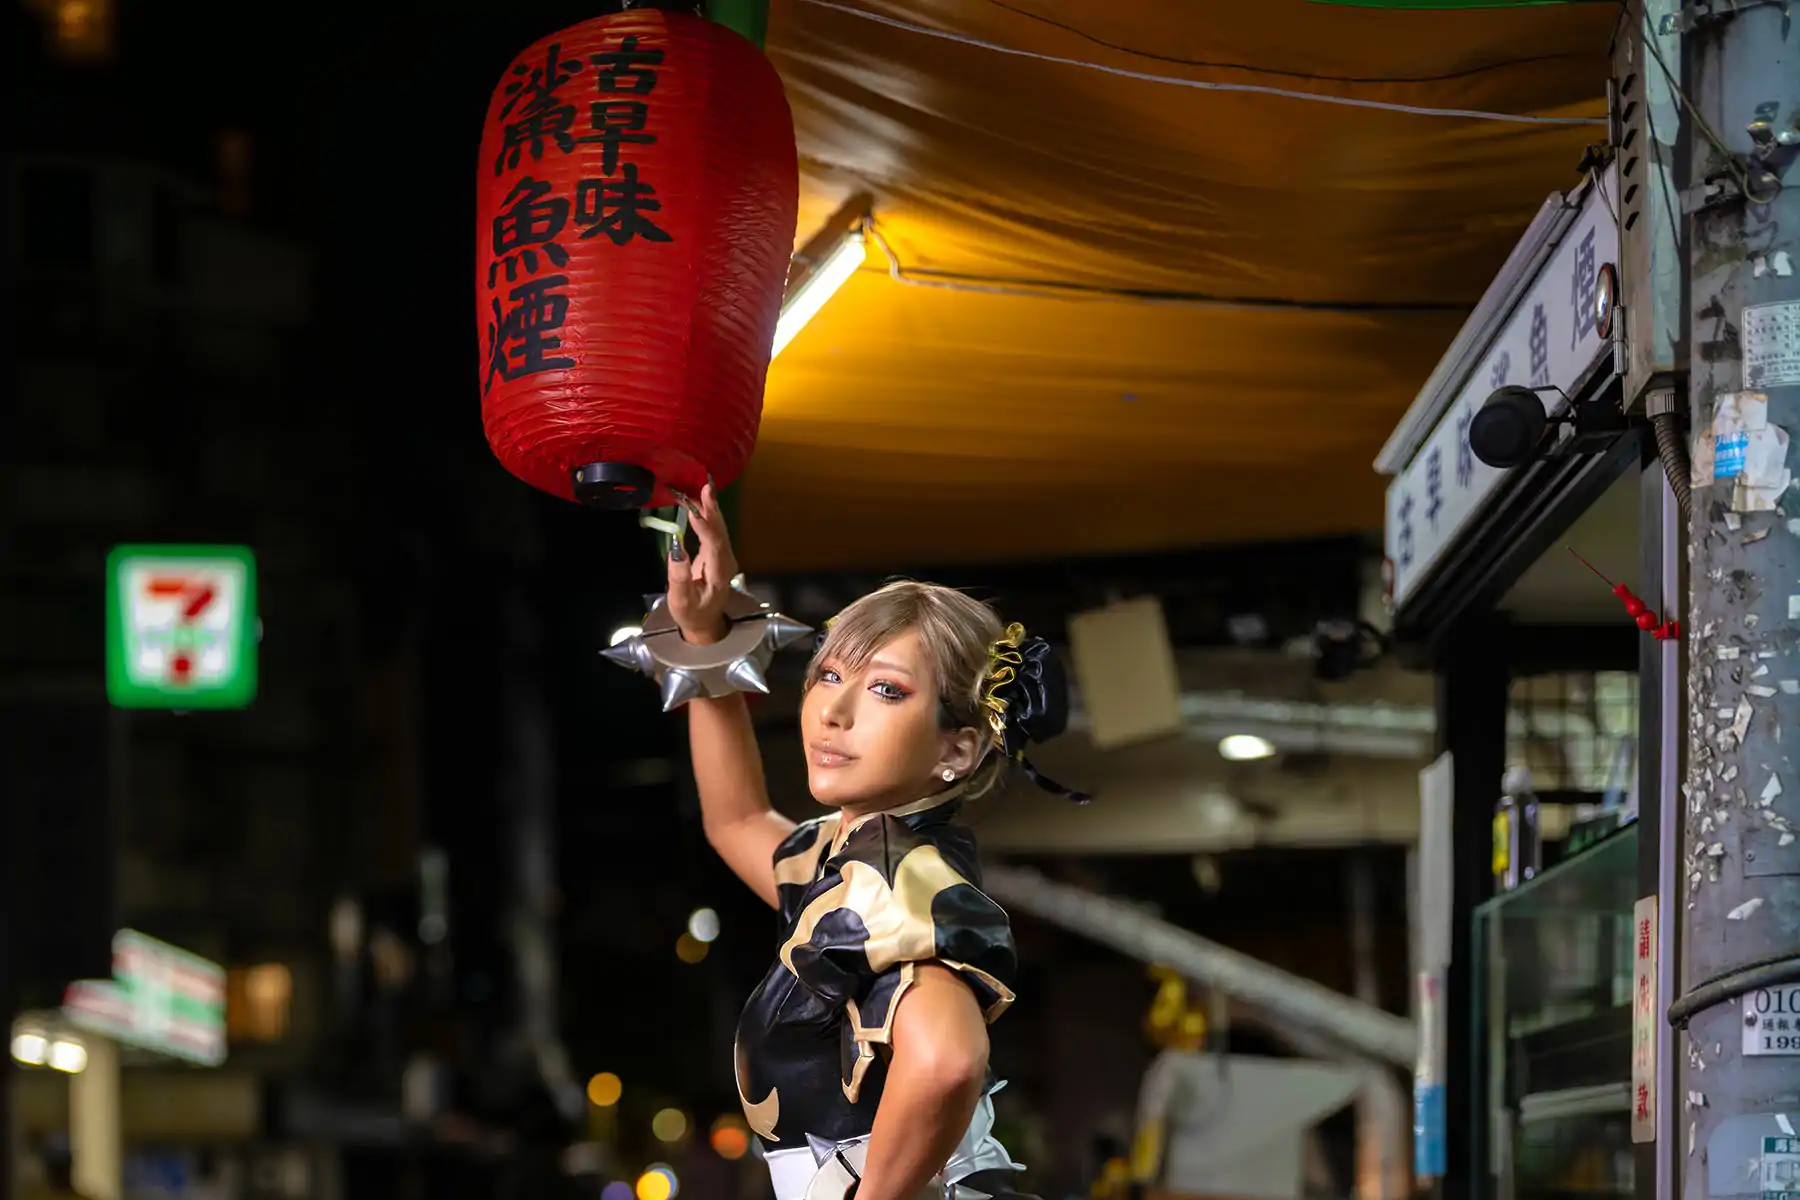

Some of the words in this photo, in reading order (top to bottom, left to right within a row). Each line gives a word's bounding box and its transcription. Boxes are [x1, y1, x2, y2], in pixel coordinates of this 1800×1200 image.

[484, 43, 582, 396] 鯊魚煙
[573, 35, 674, 246] 古早味
